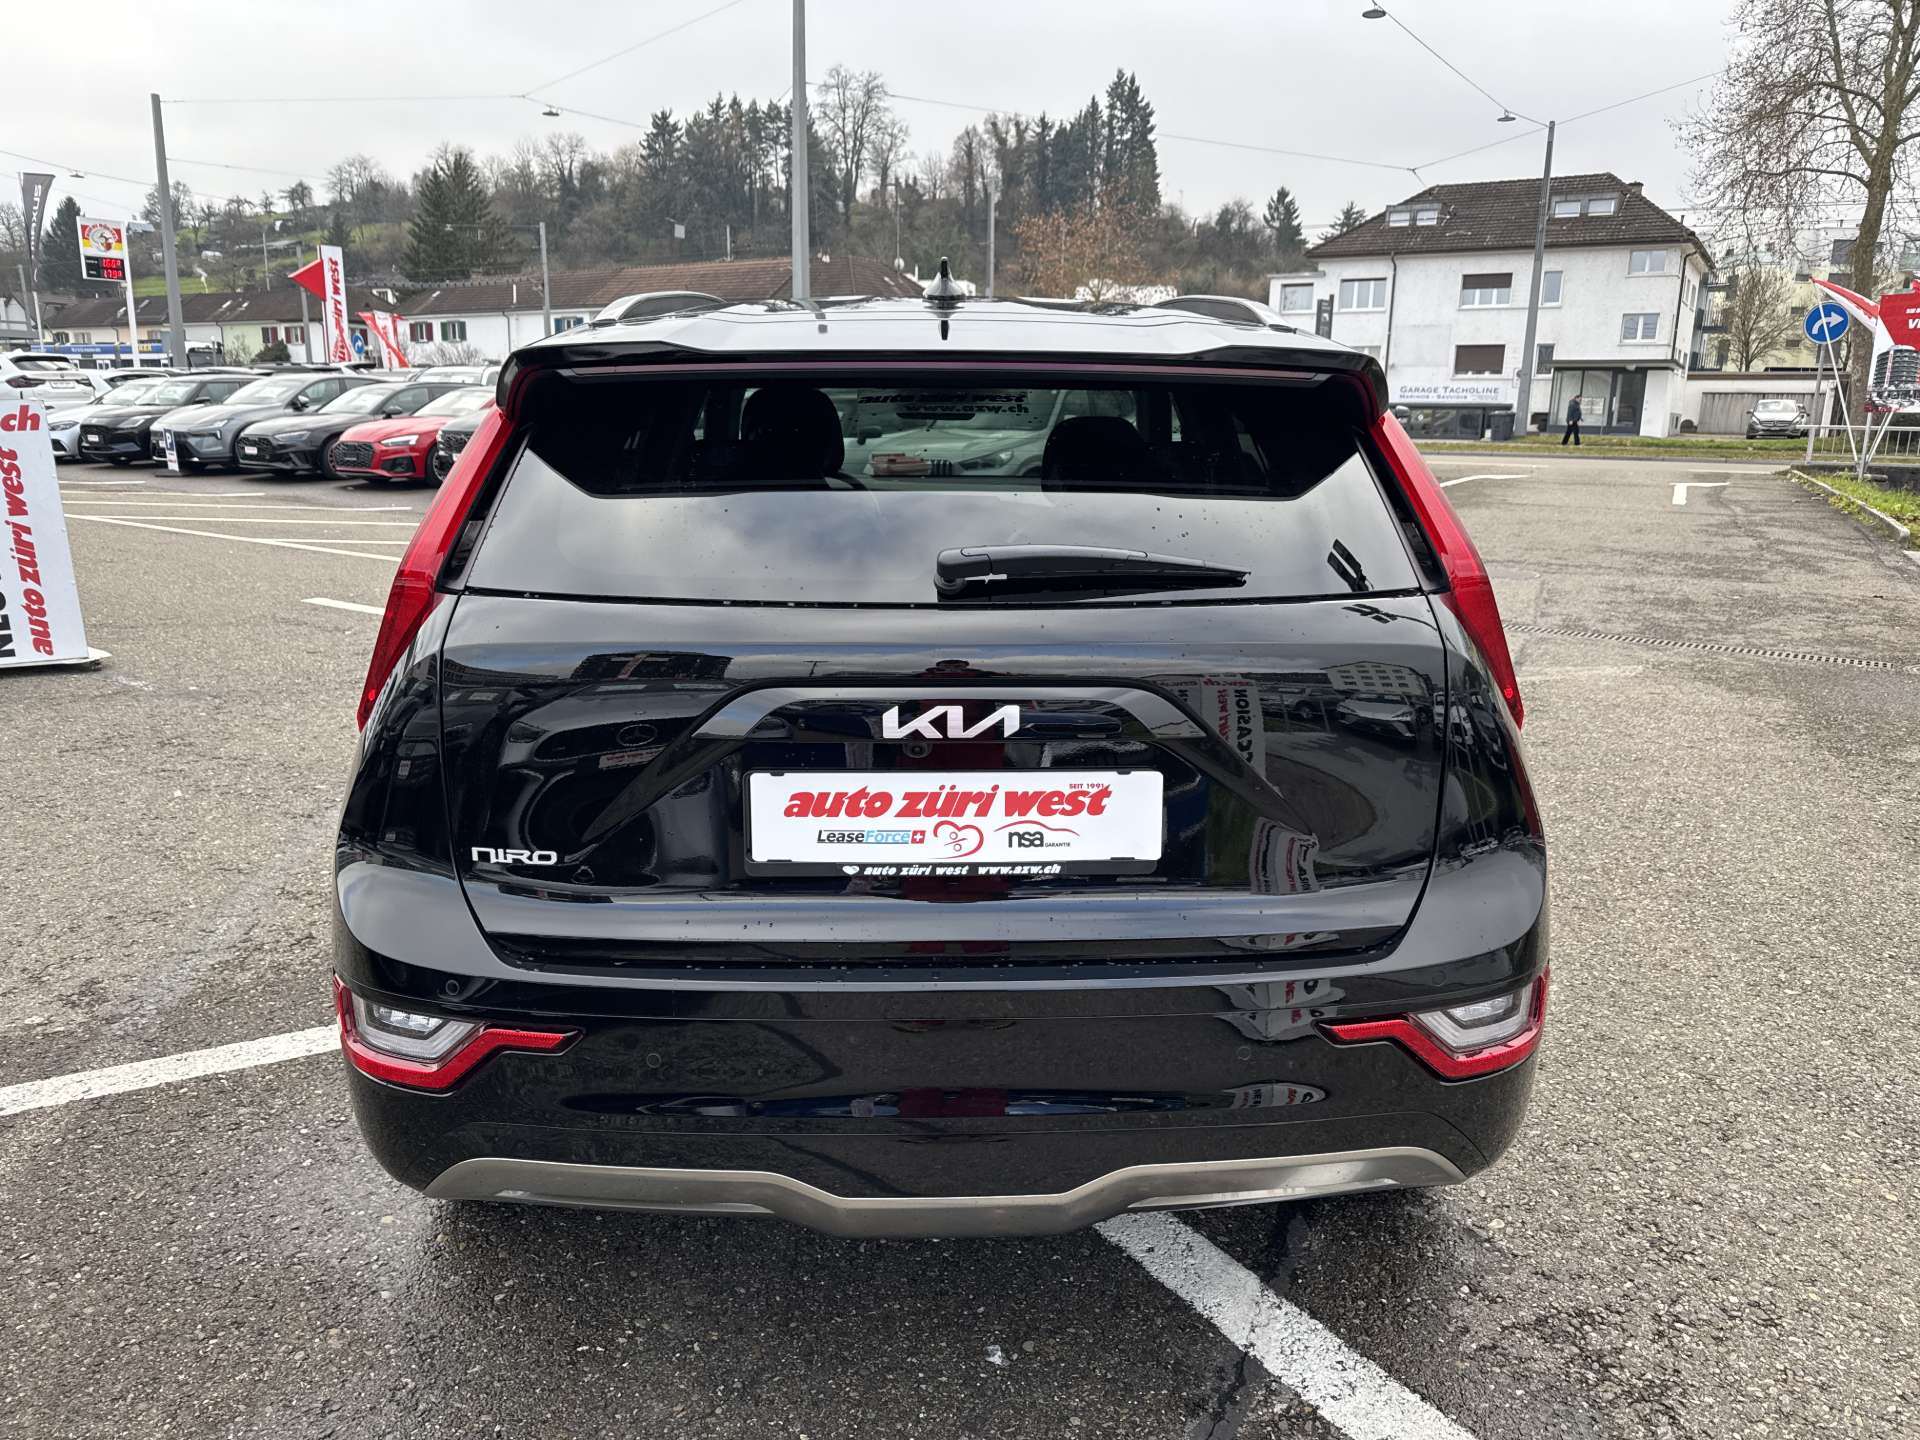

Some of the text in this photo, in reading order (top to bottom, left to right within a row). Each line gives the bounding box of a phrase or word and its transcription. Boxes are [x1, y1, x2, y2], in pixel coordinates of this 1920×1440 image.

[1400, 385, 1499, 394] GARAGE TACHOLINE
[0, 446, 29, 517] west
[4, 520, 42, 586] züri
[20, 587, 54, 657] auto
[882, 705, 1020, 739] KIA
[783, 784, 1113, 818] auto züri west
[817, 829, 911, 844] LeaseForce
[1008, 831, 1044, 848] nsa
[471, 846, 558, 866] NIRO
[863, 863, 1062, 876] auto züri west www.azw.ch
